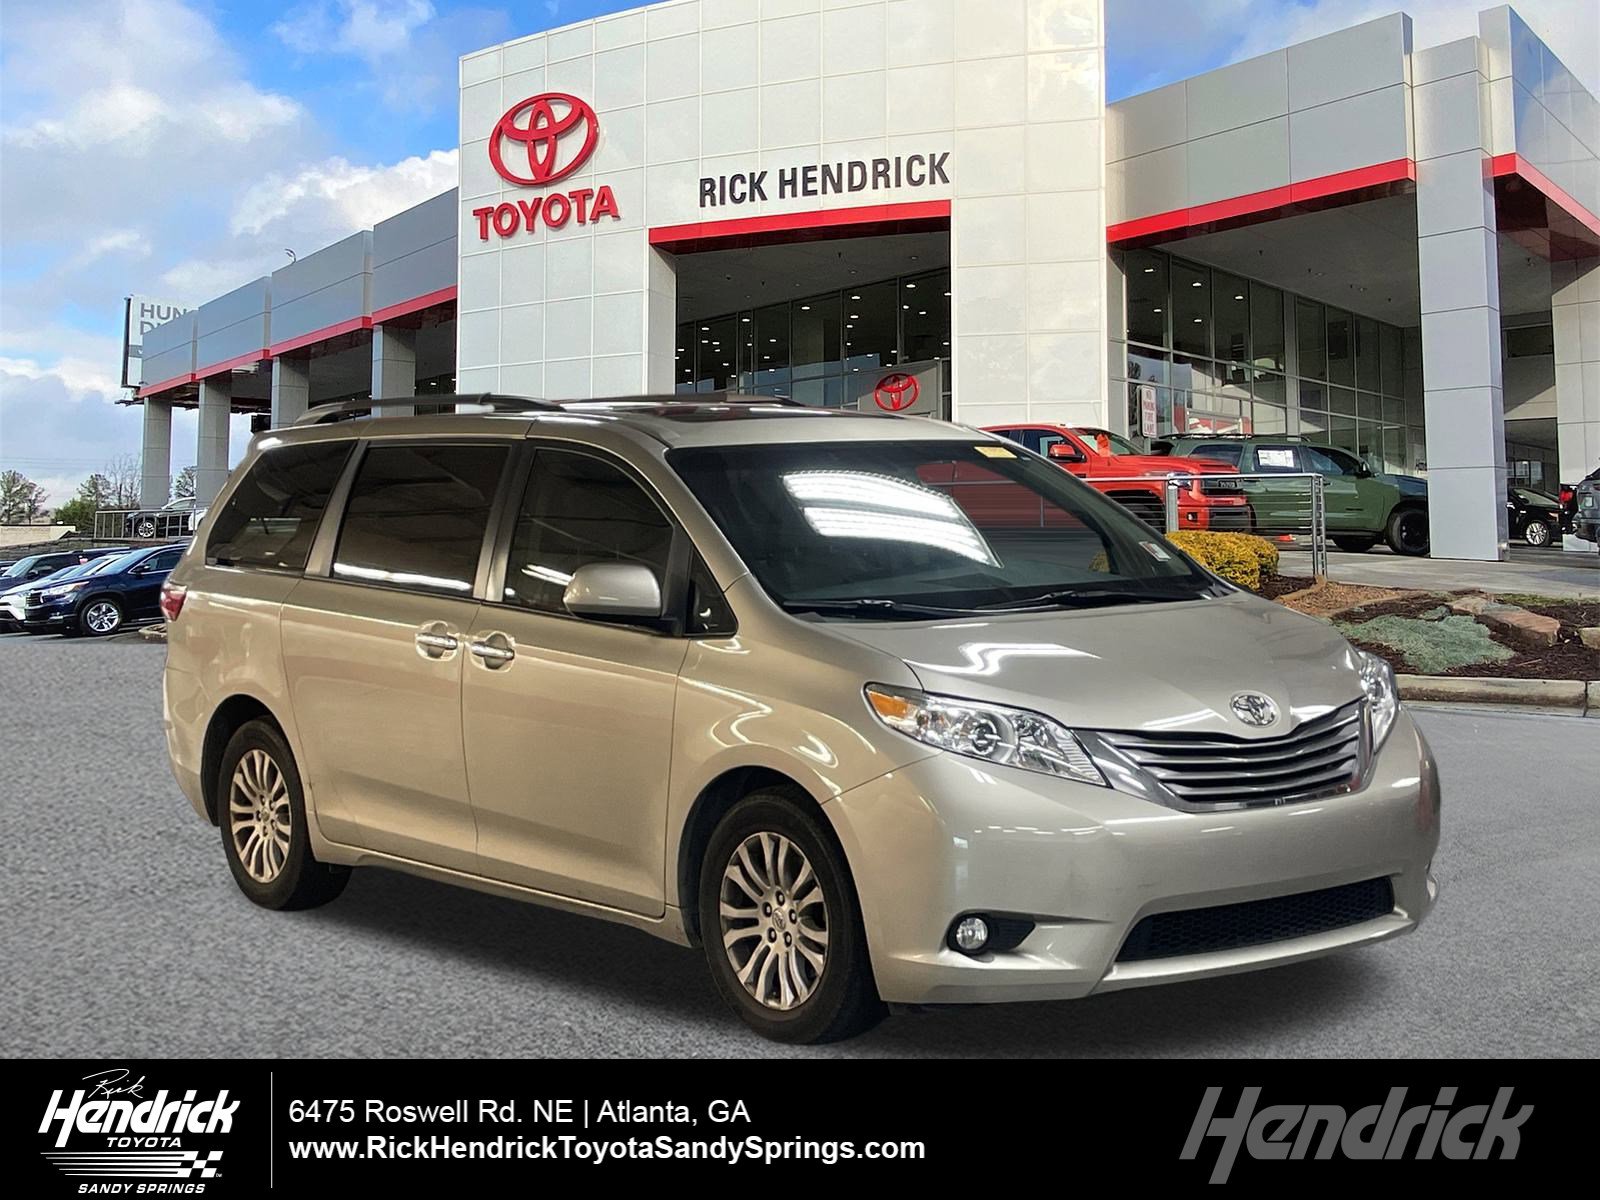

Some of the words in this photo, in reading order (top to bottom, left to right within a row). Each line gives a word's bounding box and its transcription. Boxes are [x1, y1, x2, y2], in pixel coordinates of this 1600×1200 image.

[699, 171, 768, 208] RICK
[779, 152, 951, 200] HENDRICK
[473, 185, 621, 241] TOYOTA
